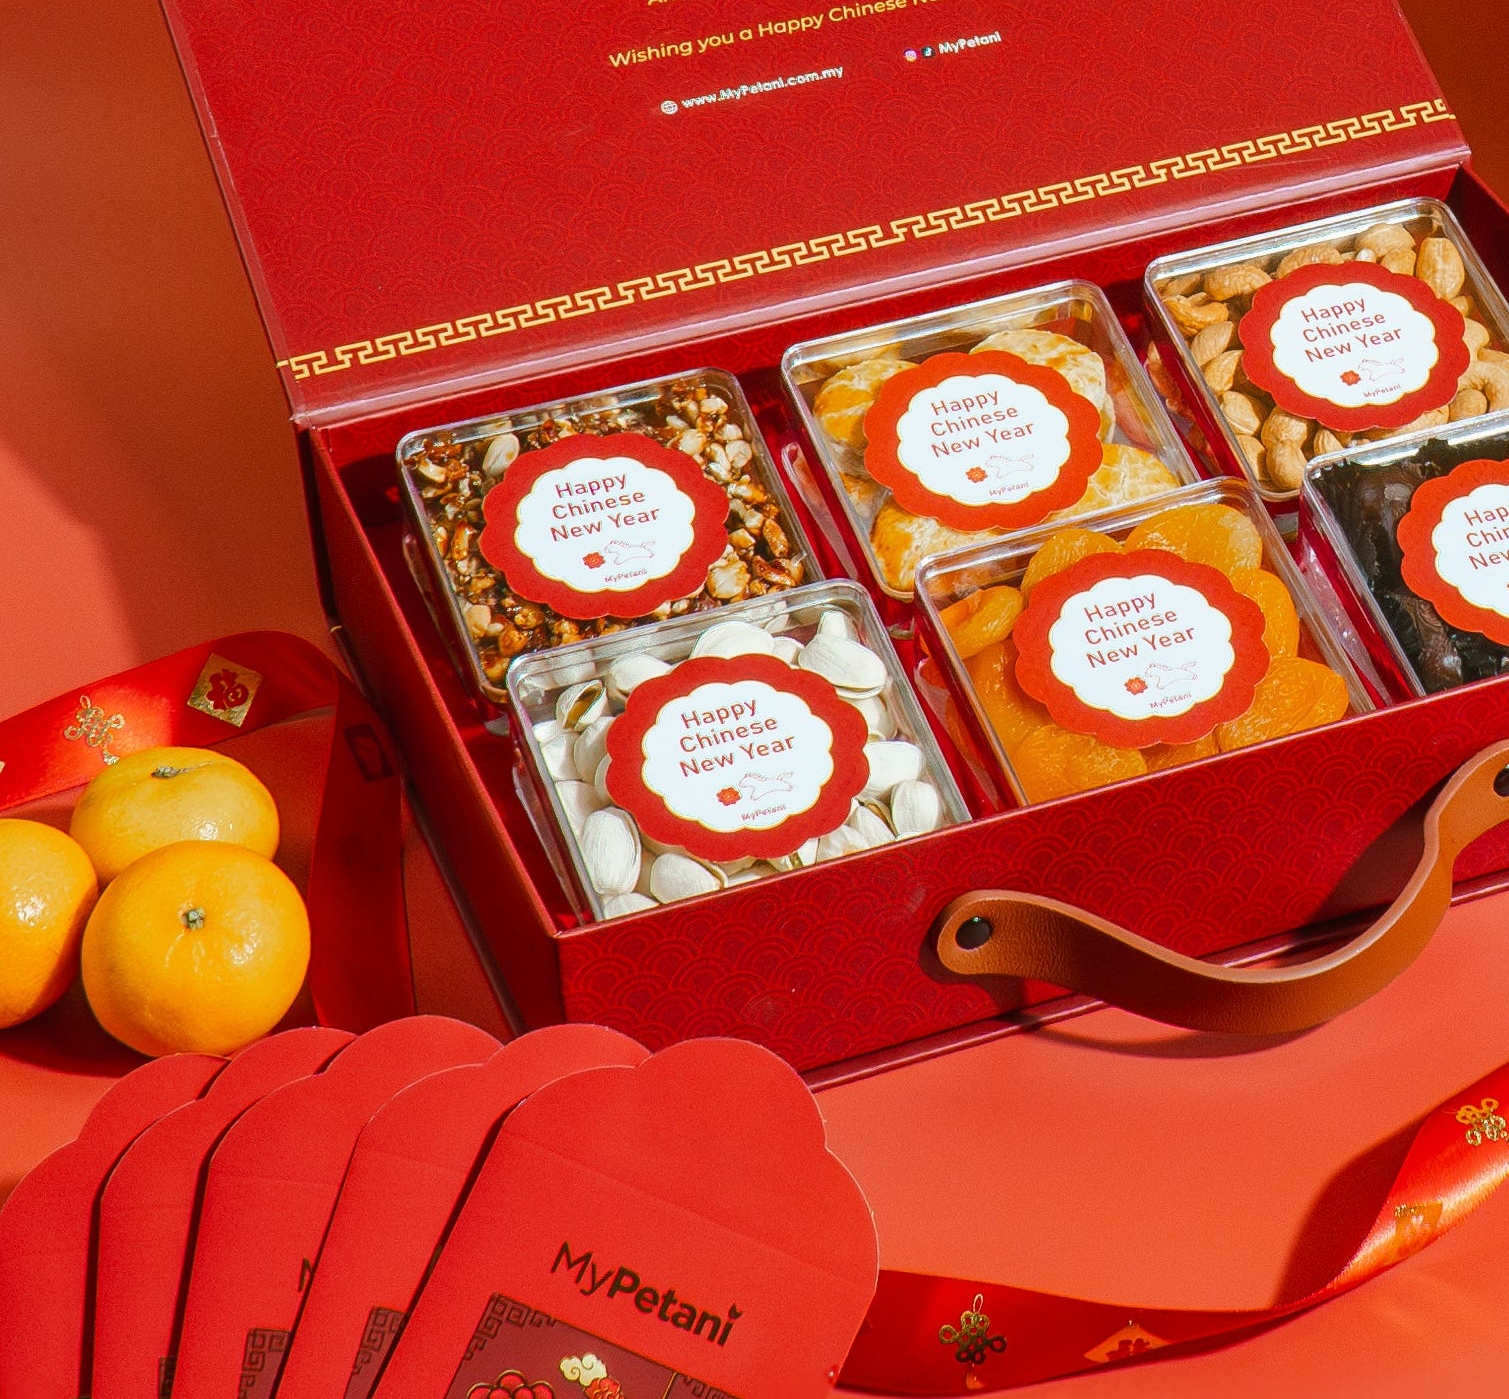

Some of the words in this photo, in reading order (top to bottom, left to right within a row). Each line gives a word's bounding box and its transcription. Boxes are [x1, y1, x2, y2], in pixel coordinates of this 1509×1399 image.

[608, 40, 693, 68] Wishing
[696, 32, 735, 54] you
[738, 28, 753, 41] a
[757, 13, 824, 38] Happy
[938, 30, 1002, 55] MyPetani
[680, 65, 845, 110] www.MyPetani.com.my
[1300, 298, 1366, 323] Happy
[1302, 313, 1386, 343] Chinese
[1304, 342, 1352, 363] New
[1355, 327, 1403, 350] Year
[930, 390, 998, 416] Happy
[930, 406, 1019, 437] Chinese
[931, 436, 980, 458] New
[984, 422, 1035, 444] Year
[554, 473, 627, 499] Happy
[551, 491, 646, 520] Chinese
[549, 520, 602, 542] New
[607, 507, 661, 529] Year
[1083, 592, 1156, 623] Happy
[1084, 610, 1178, 645] Chinese
[1086, 644, 1138, 669] New
[1141, 627, 1195, 651] Year
[680, 699, 757, 730] Happy
[679, 718, 778, 753] Chinese
[678, 752, 735, 778] New
[738, 736, 795, 760] Year
[550, 1241, 743, 1347] MyPetani
